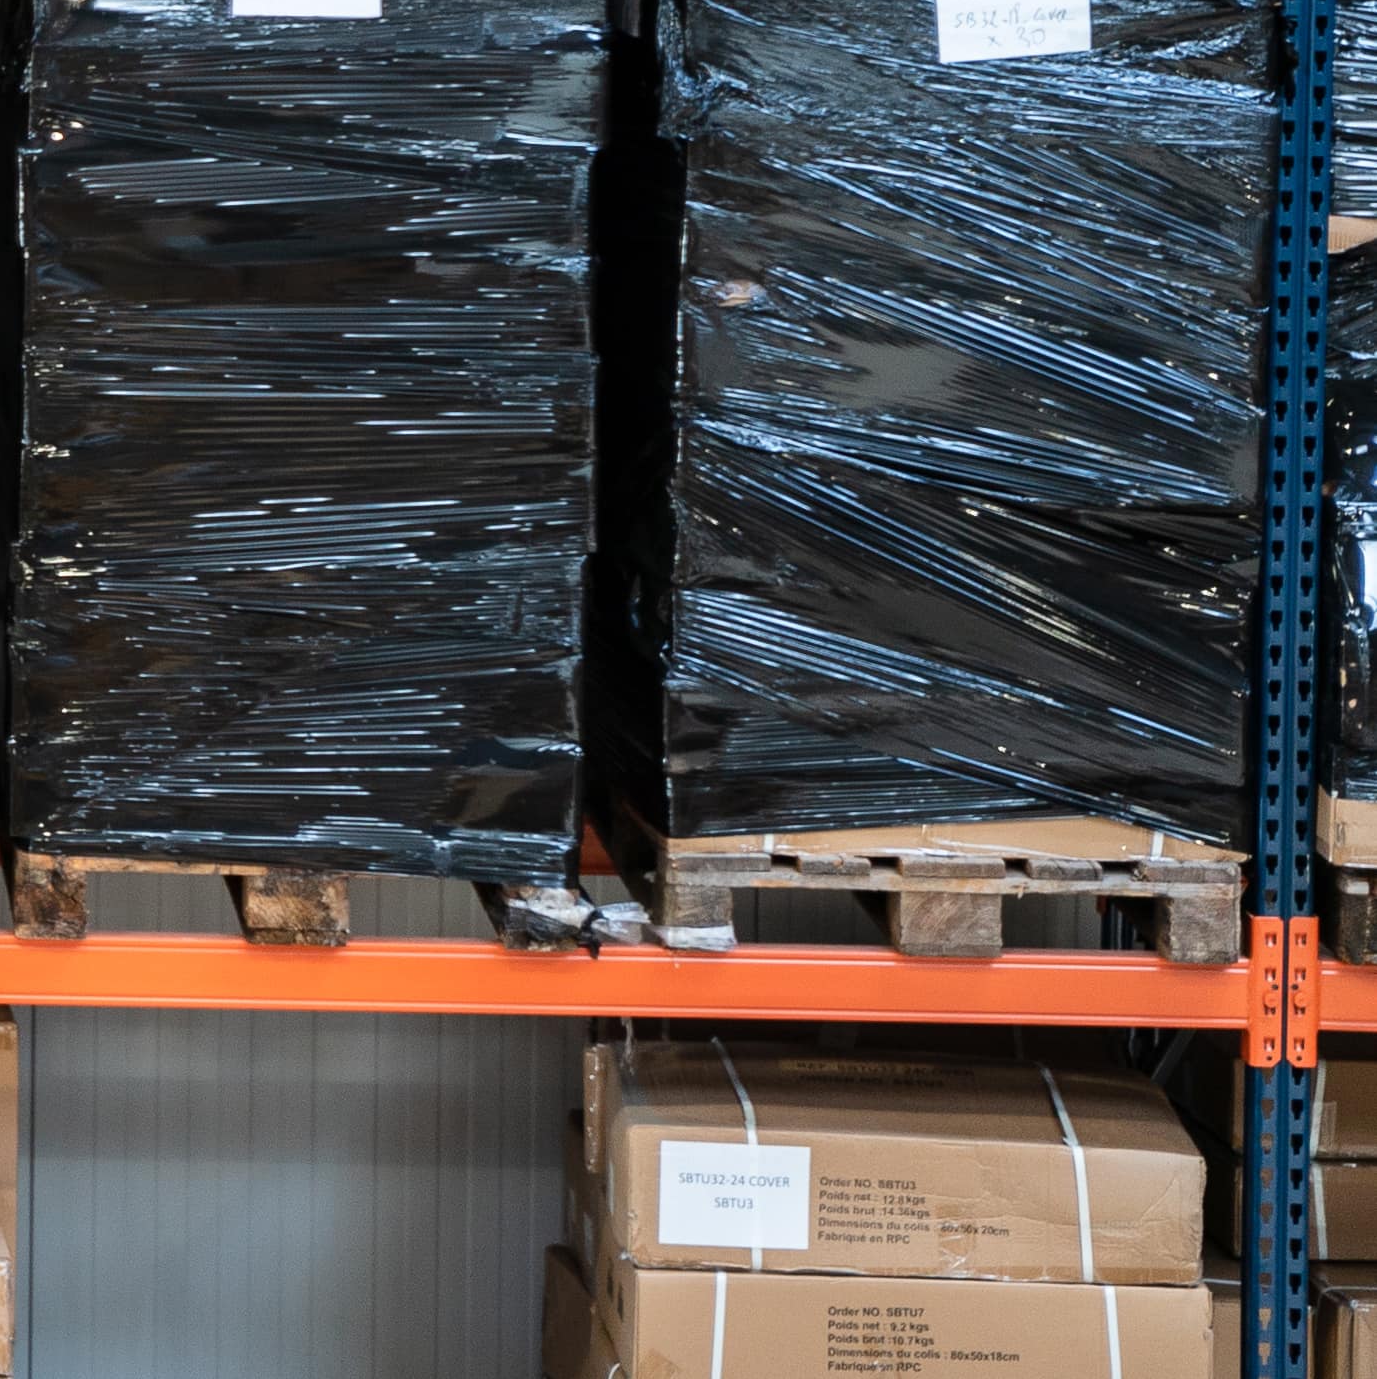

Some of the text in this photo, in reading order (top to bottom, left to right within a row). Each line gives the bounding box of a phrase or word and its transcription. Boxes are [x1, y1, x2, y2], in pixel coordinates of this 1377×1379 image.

[679, 1172, 790, 1188] SBTU32-24 COVER
[819, 1177, 851, 1187] Order
[819, 1190, 851, 1201] Poids
[714, 1196, 754, 1210] SBTU3
[819, 1203, 850, 1214] Poids
[818, 1217, 883, 1230] Dimensions
[886, 1233, 911, 1245] RPC
[828, 1306, 859, 1317] Order
[886, 1308, 925, 1318] SBTU7
[828, 1320, 859, 1331] Poids
[890, 1323, 906, 1332] 9.2
[909, 1323, 929, 1334] kgs
[828, 1334, 859, 1344] Poids
[828, 1347, 894, 1359] Dimensions
[897, 1349, 911, 1359] du
[914, 1350, 941, 1360] colis
[897, 1363, 922, 1373] RPC
